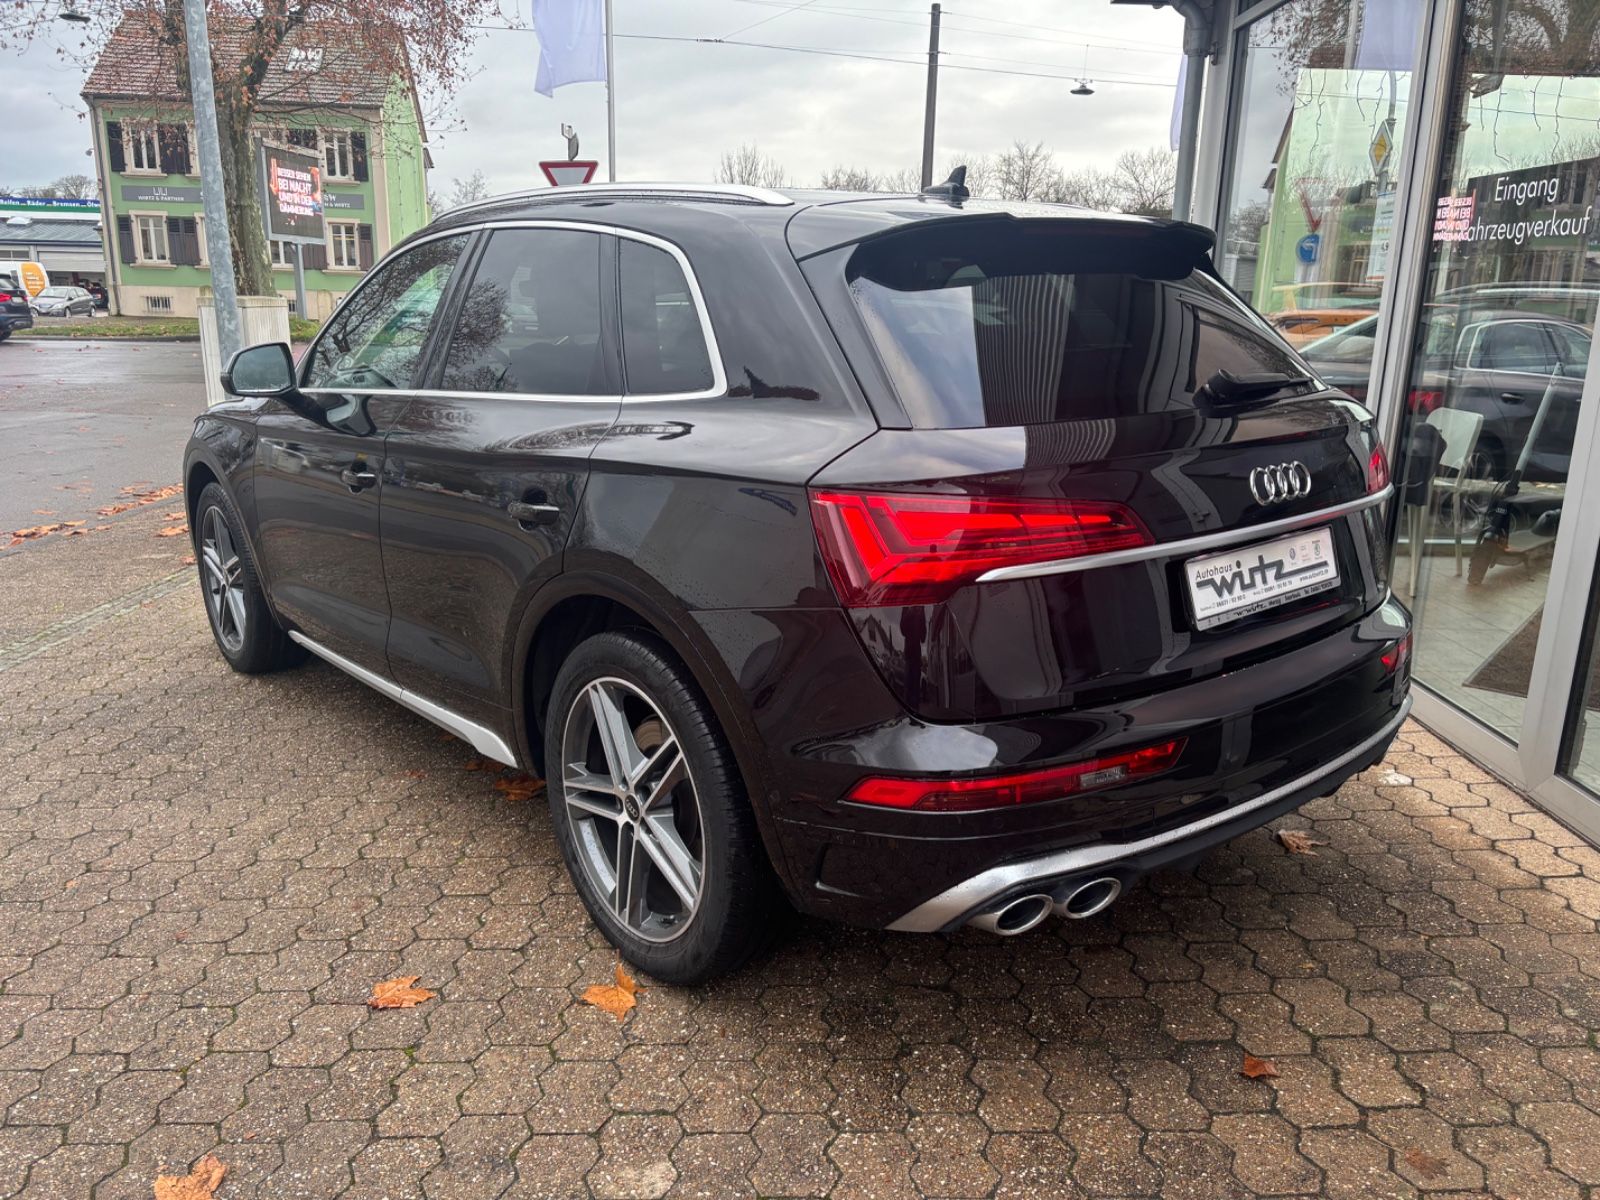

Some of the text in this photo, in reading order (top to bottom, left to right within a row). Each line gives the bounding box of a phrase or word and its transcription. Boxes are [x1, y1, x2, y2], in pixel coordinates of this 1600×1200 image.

[278, 178, 312, 194] BEI NACHT
[1494, 176, 1560, 206] Eingang
[1467, 205, 1593, 245] ahrzeugverkauf
[1195, 564, 1233, 581] Autohaus
